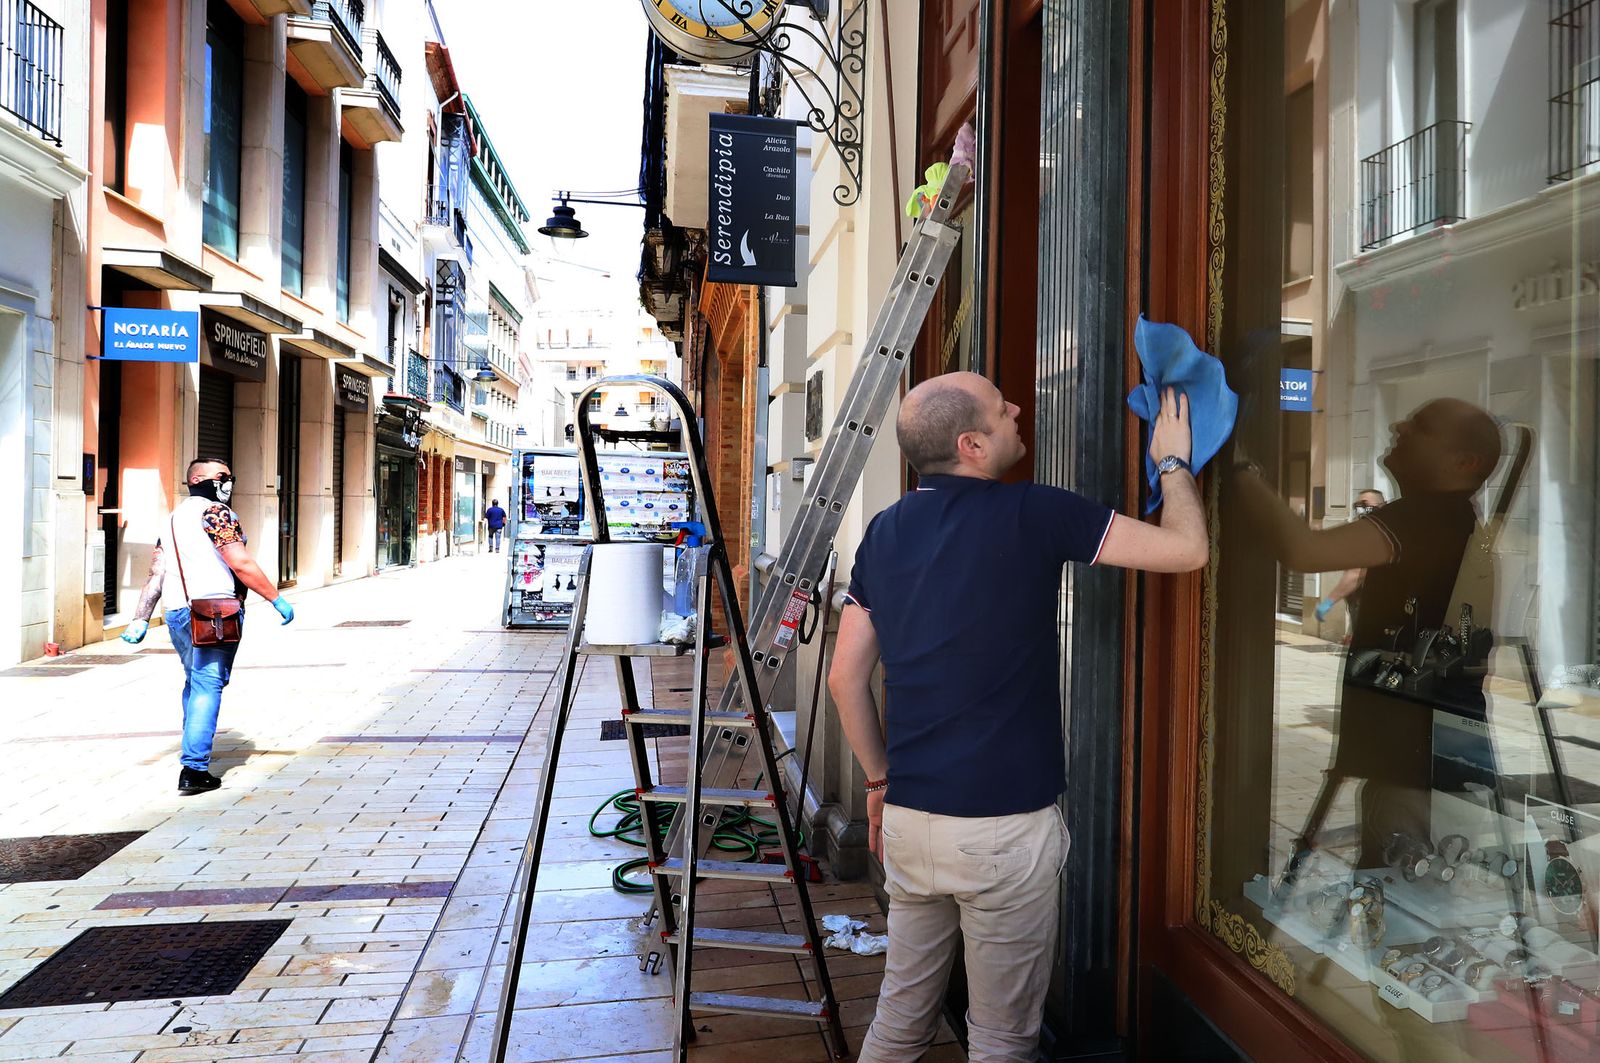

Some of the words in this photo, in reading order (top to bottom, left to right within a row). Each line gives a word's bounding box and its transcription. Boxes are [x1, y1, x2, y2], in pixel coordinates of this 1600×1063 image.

[763, 145, 791, 153] Arazola
[763, 165, 791, 174] Cachito
[713, 133, 736, 266] Serendipia
[775, 193, 791, 201] Duo
[775, 213, 790, 221] Rua
[113, 322, 189, 338] NOTARÍA
[214, 321, 267, 359] SPRINGFIELD
[157, 343, 187, 351] NUEVO
[1550, 810, 1574, 825] CLUSE
[1384, 984, 1403, 999] CLUSE
